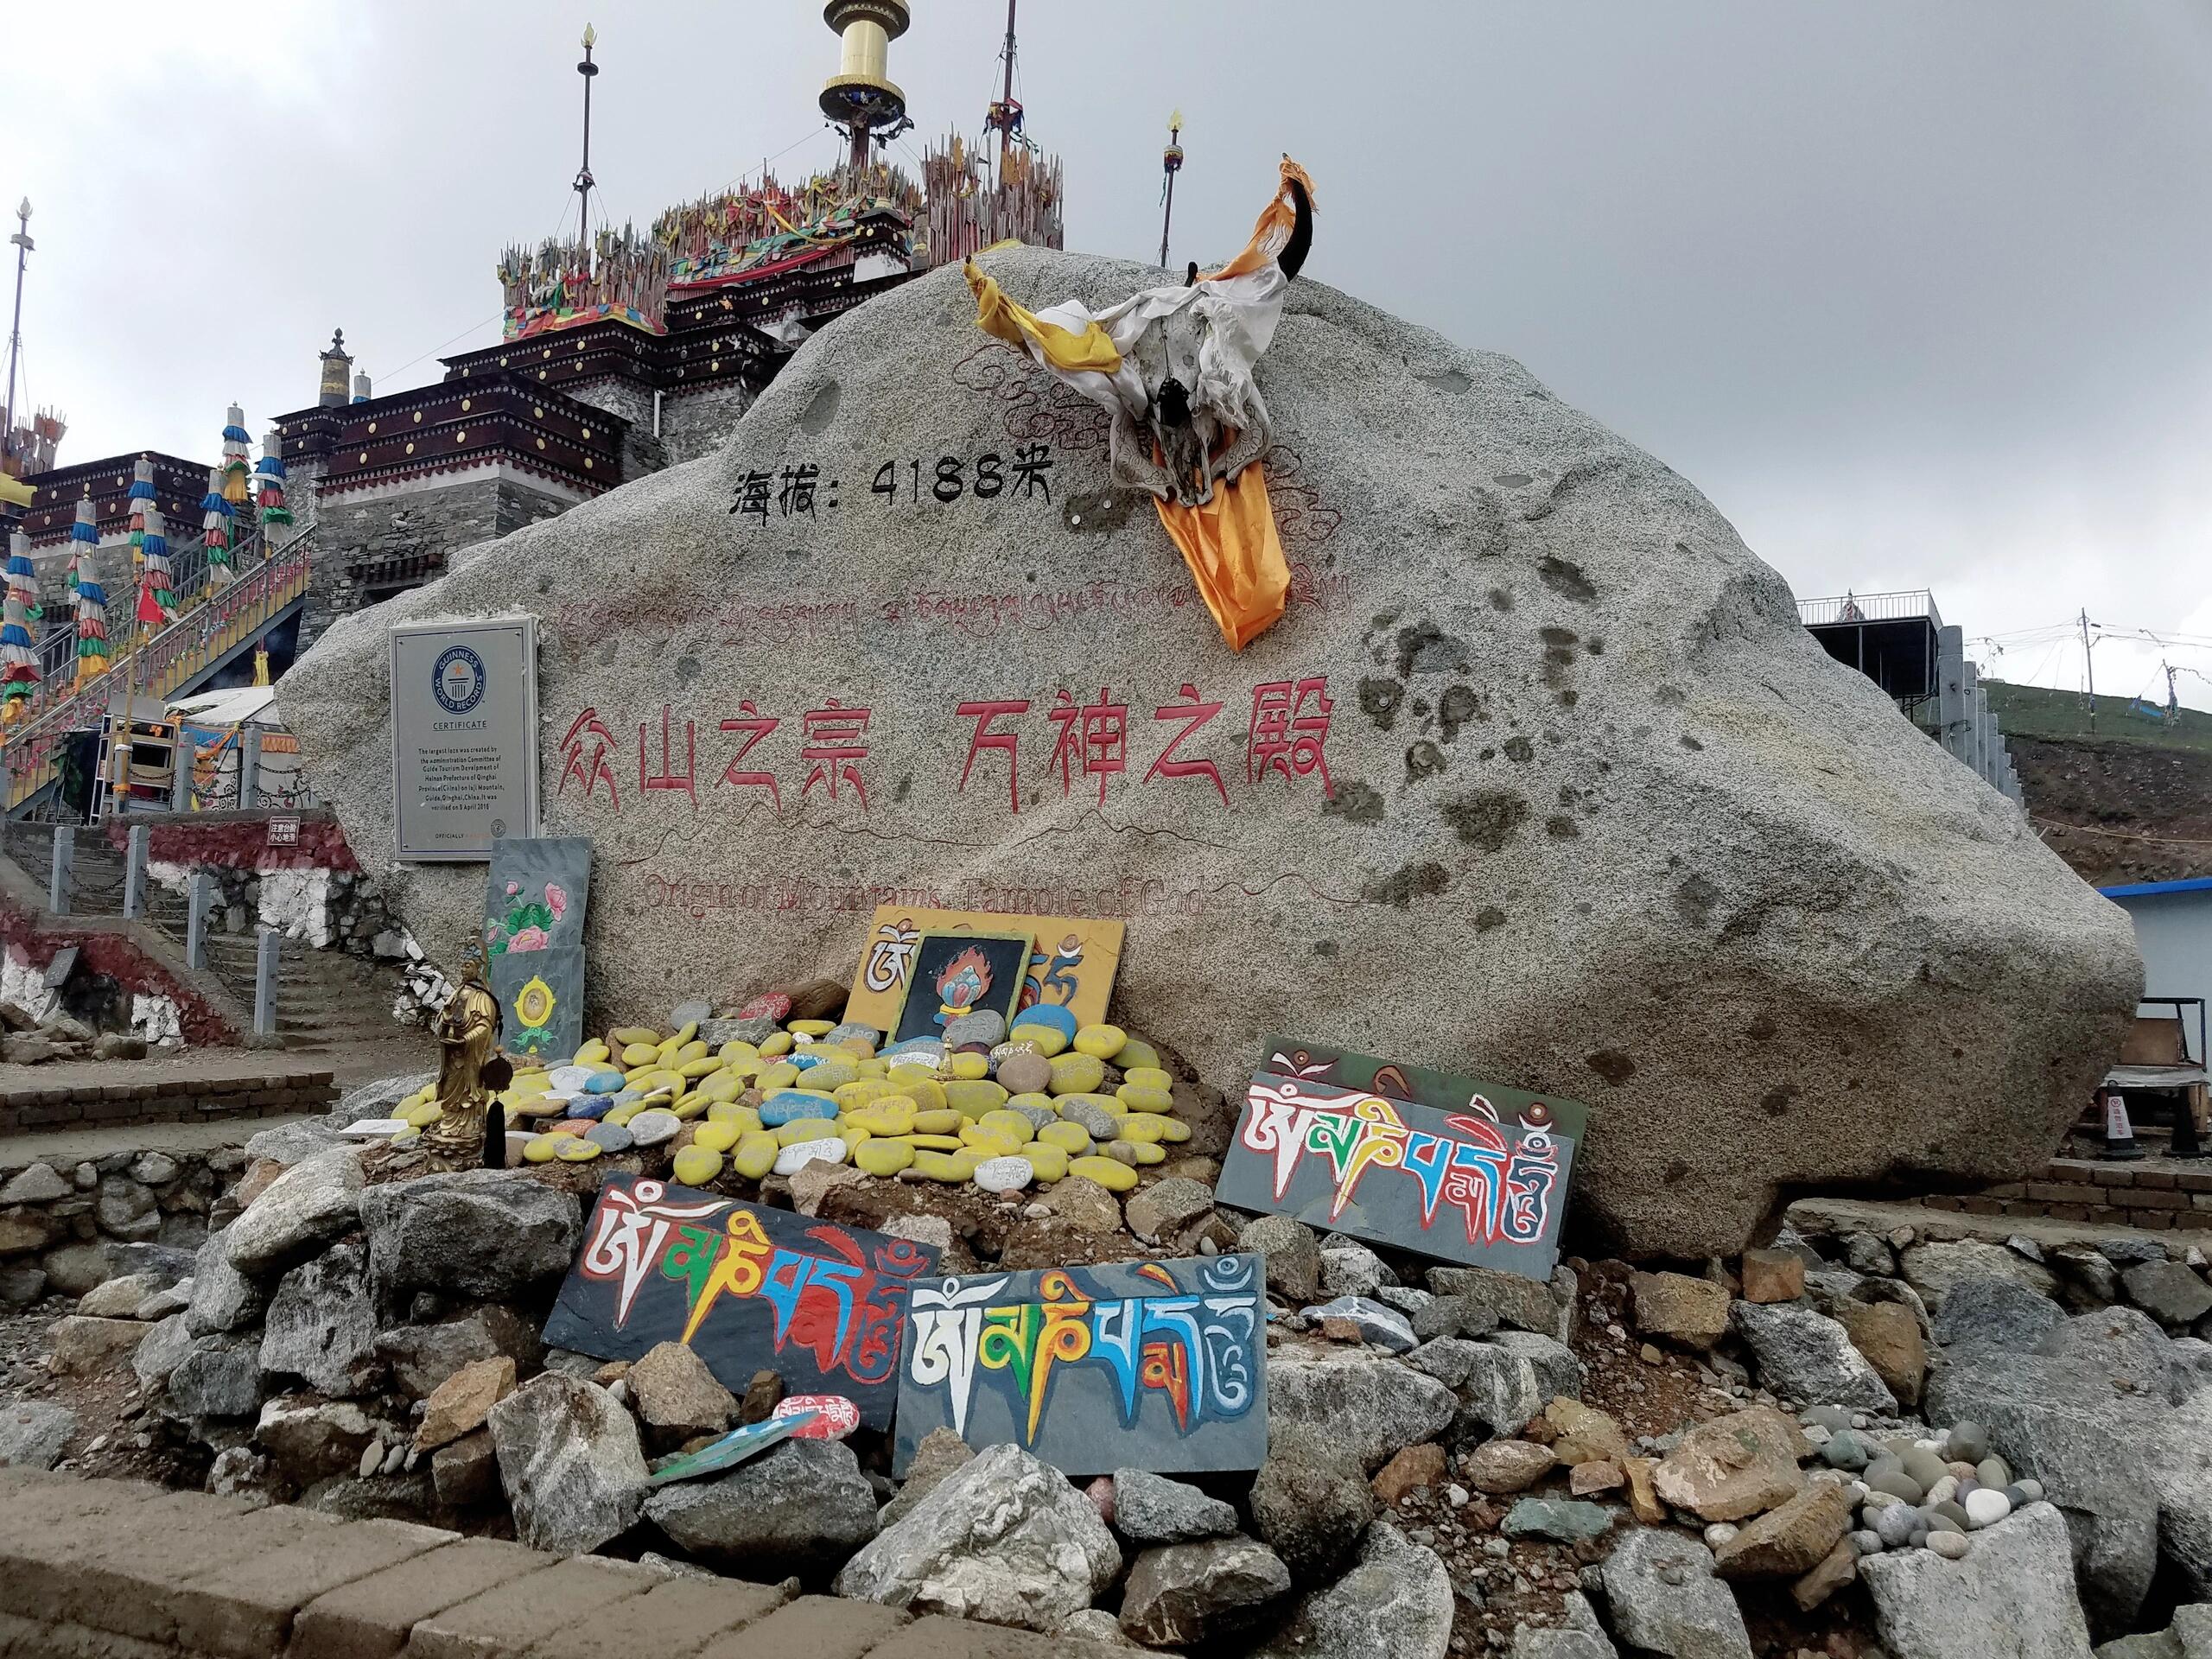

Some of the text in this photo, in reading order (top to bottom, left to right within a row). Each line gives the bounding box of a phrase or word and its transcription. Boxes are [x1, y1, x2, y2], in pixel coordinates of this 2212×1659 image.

[439, 651, 478, 671] GUINNESS
[435, 674, 483, 710] WORLD RECORDS
[433, 720, 487, 730] CERTIFICATE
[557, 675, 1335, 815] 众山之宗 万神之殿
[646, 874, 734, 918] Origin
[741, 874, 773, 909] of
[1096, 876, 1140, 918] of
[1140, 875, 1205, 918] God
